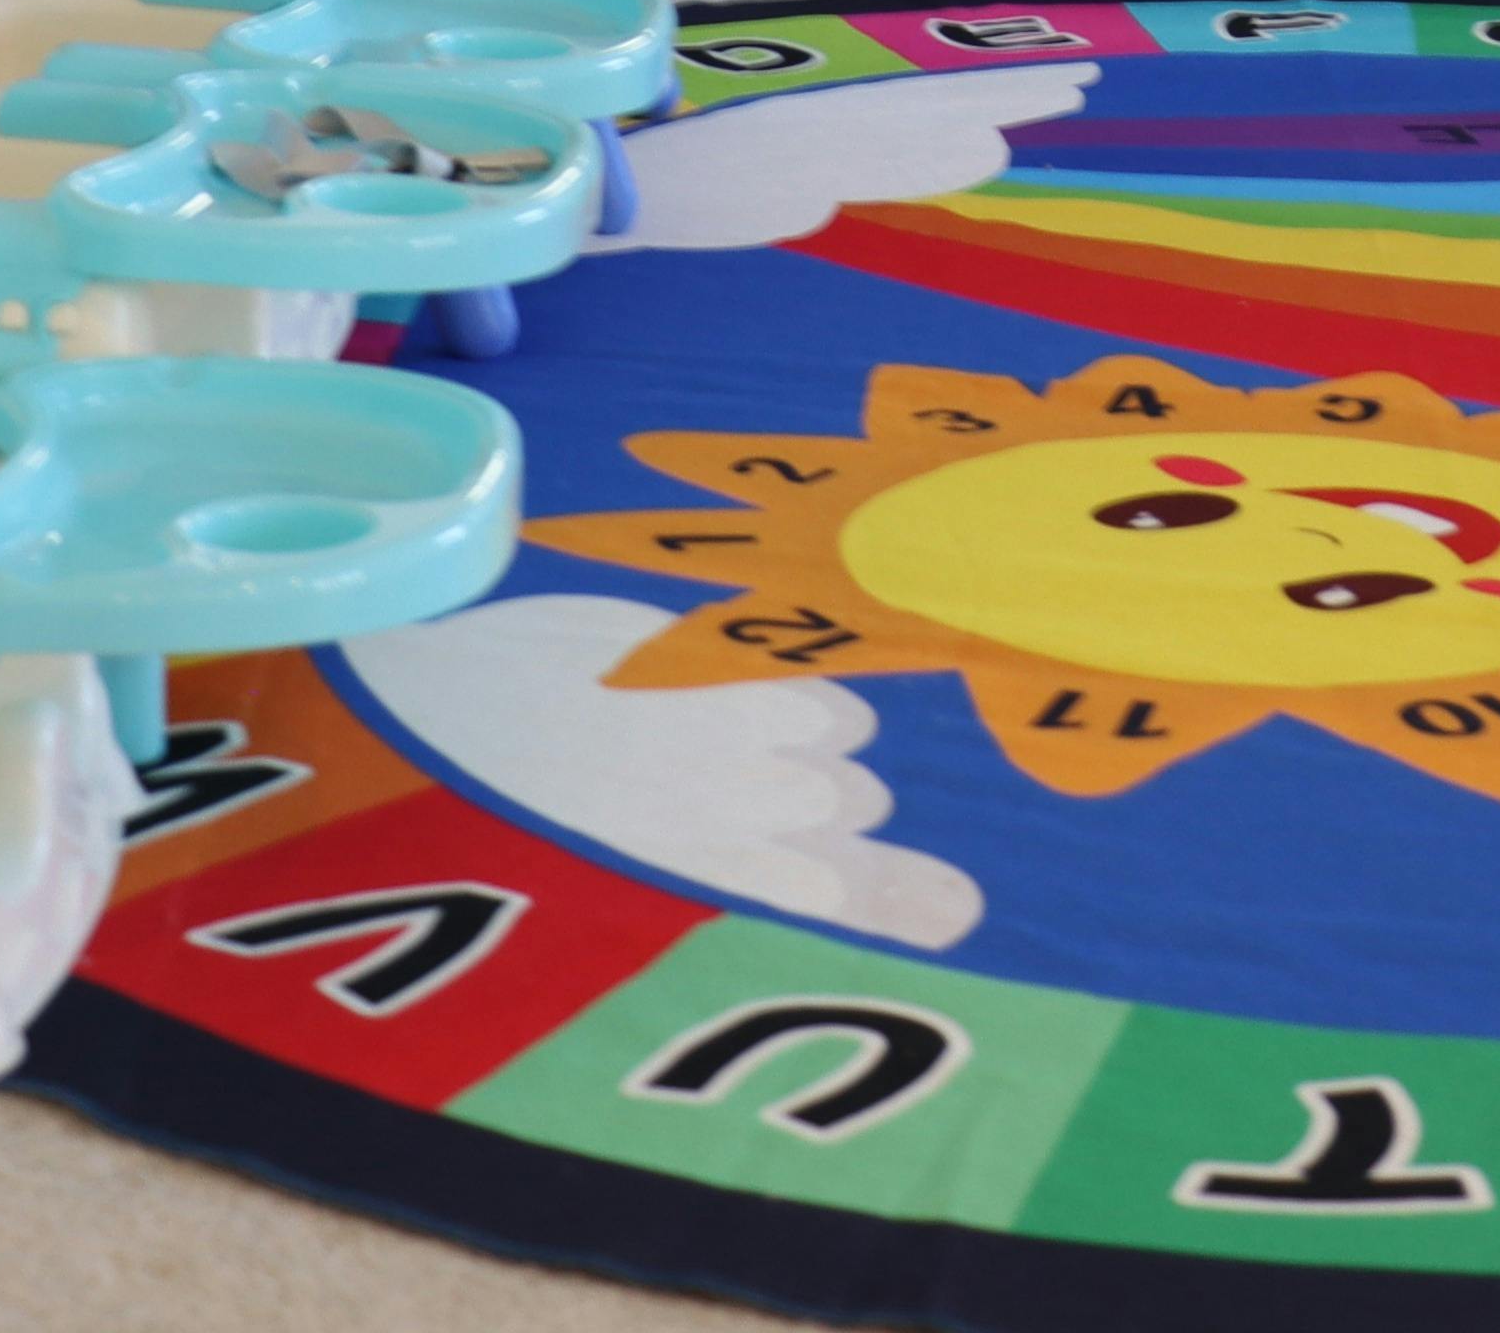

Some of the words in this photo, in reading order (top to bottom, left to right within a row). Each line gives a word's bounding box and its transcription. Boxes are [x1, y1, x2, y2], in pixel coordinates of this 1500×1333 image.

[926, 15, 1093, 52] E
[913, 407, 998, 432] 3
[1105, 383, 1174, 419] 4
[1314, 394, 1384, 423] 5
[729, 456, 836, 484] 2
[654, 533, 758, 551] 1
[721, 607, 861, 663] 12
[1030, 690, 1171, 738] 11
[185, 880, 532, 1019] V
[620, 993, 973, 1144] U
[1172, 1075, 1495, 1215] T
